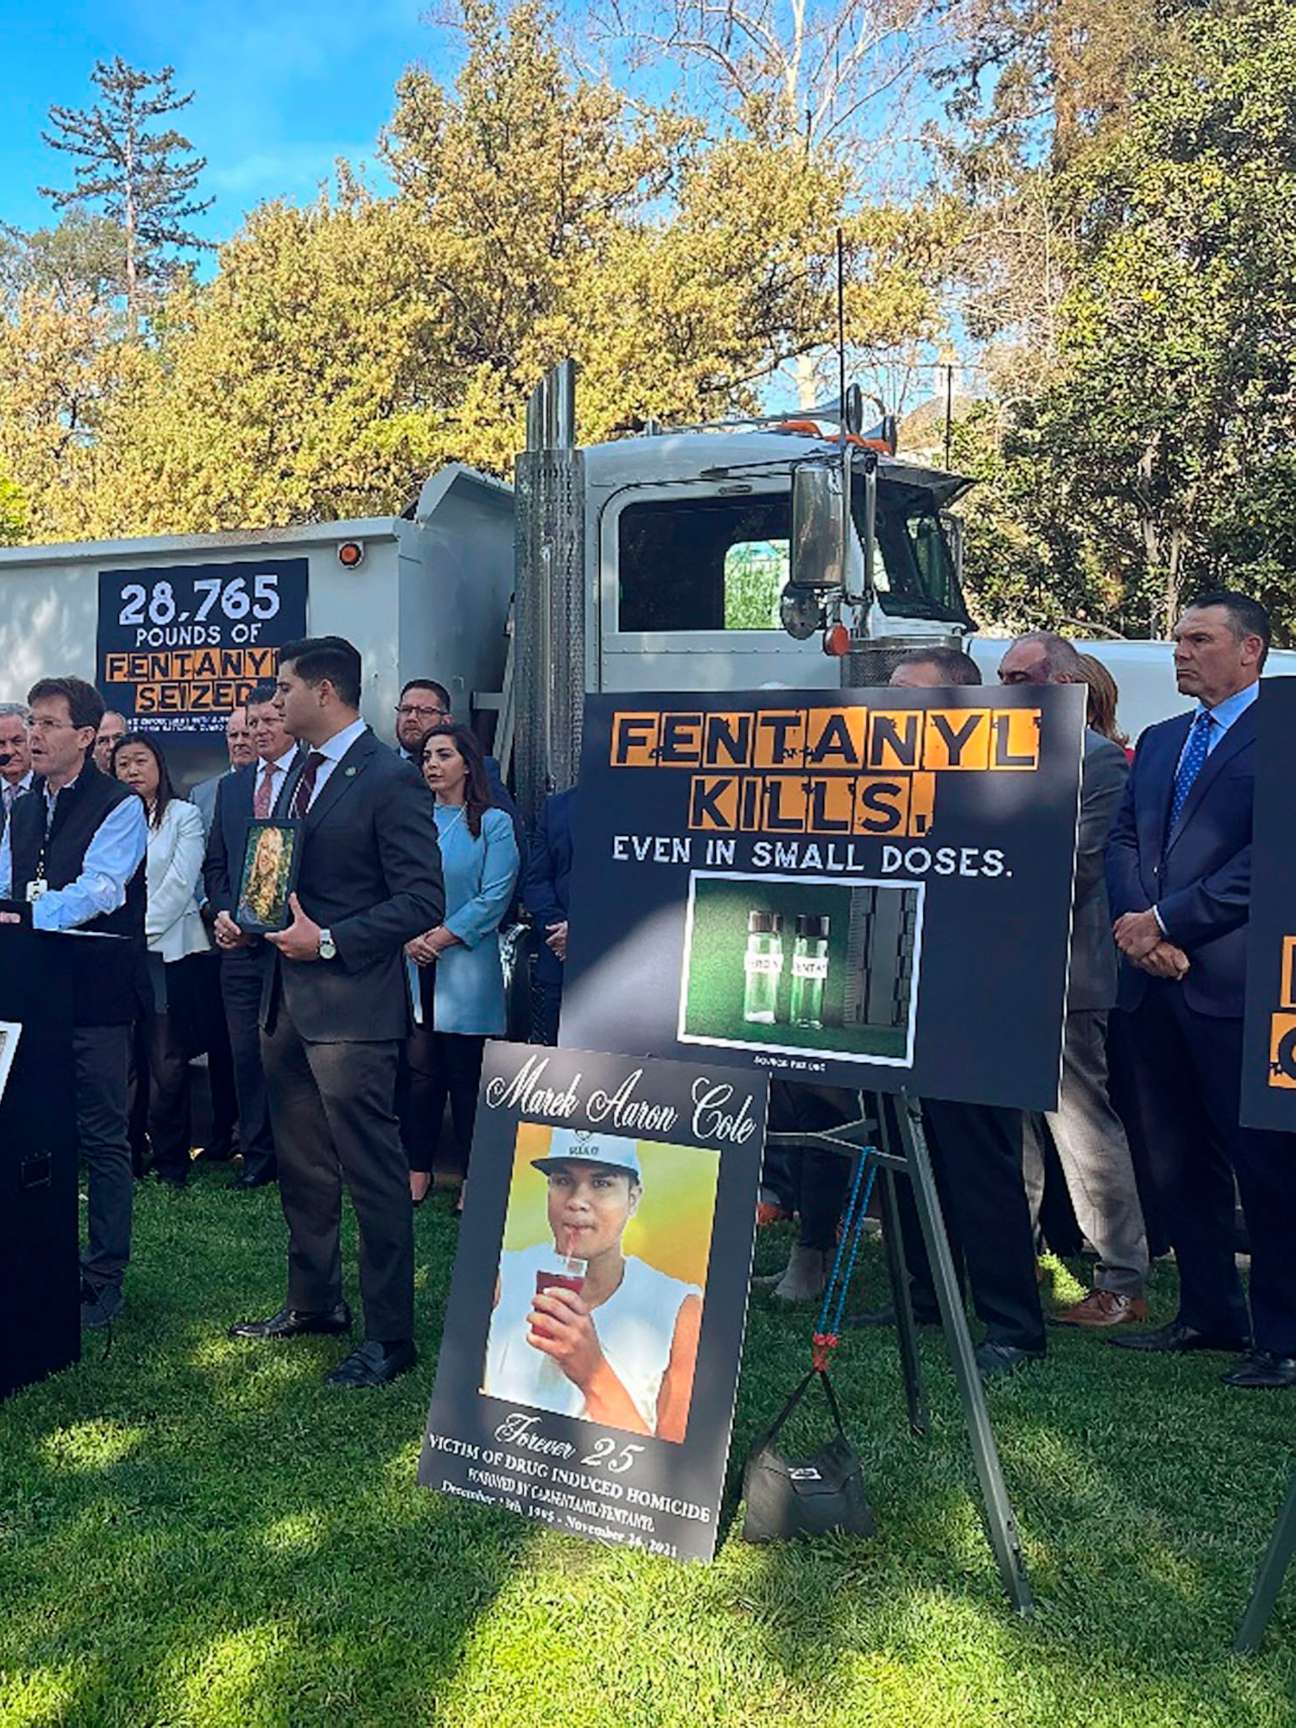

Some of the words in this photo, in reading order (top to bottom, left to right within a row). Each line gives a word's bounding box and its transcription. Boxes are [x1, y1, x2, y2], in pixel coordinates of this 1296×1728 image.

[119, 575, 280, 625] 28,765
[136, 625, 221, 647] POUNDS
[231, 623, 262, 643] OF
[616, 713, 1040, 766] FENTANYL
[612, 835, 692, 864] EVEN
[705, 839, 735, 866] IN
[752, 841, 865, 871] SMALL
[880, 845, 1013, 878] DOSES.
[486, 1053, 582, 1118] Marek
[586, 1068, 679, 1132] Aaron
[690, 1076, 757, 1144] Cole
[494, 1413, 576, 1460] Forever
[581, 1438, 645, 1473] 25
[429, 1434, 480, 1460] VICTIM
[482, 1449, 504, 1466] OF
[504, 1454, 549, 1478] DRUG
[552, 1467, 623, 1500] INDUCED
[626, 1487, 711, 1523] HOMICIDE
[565, 1515, 624, 1543] November
